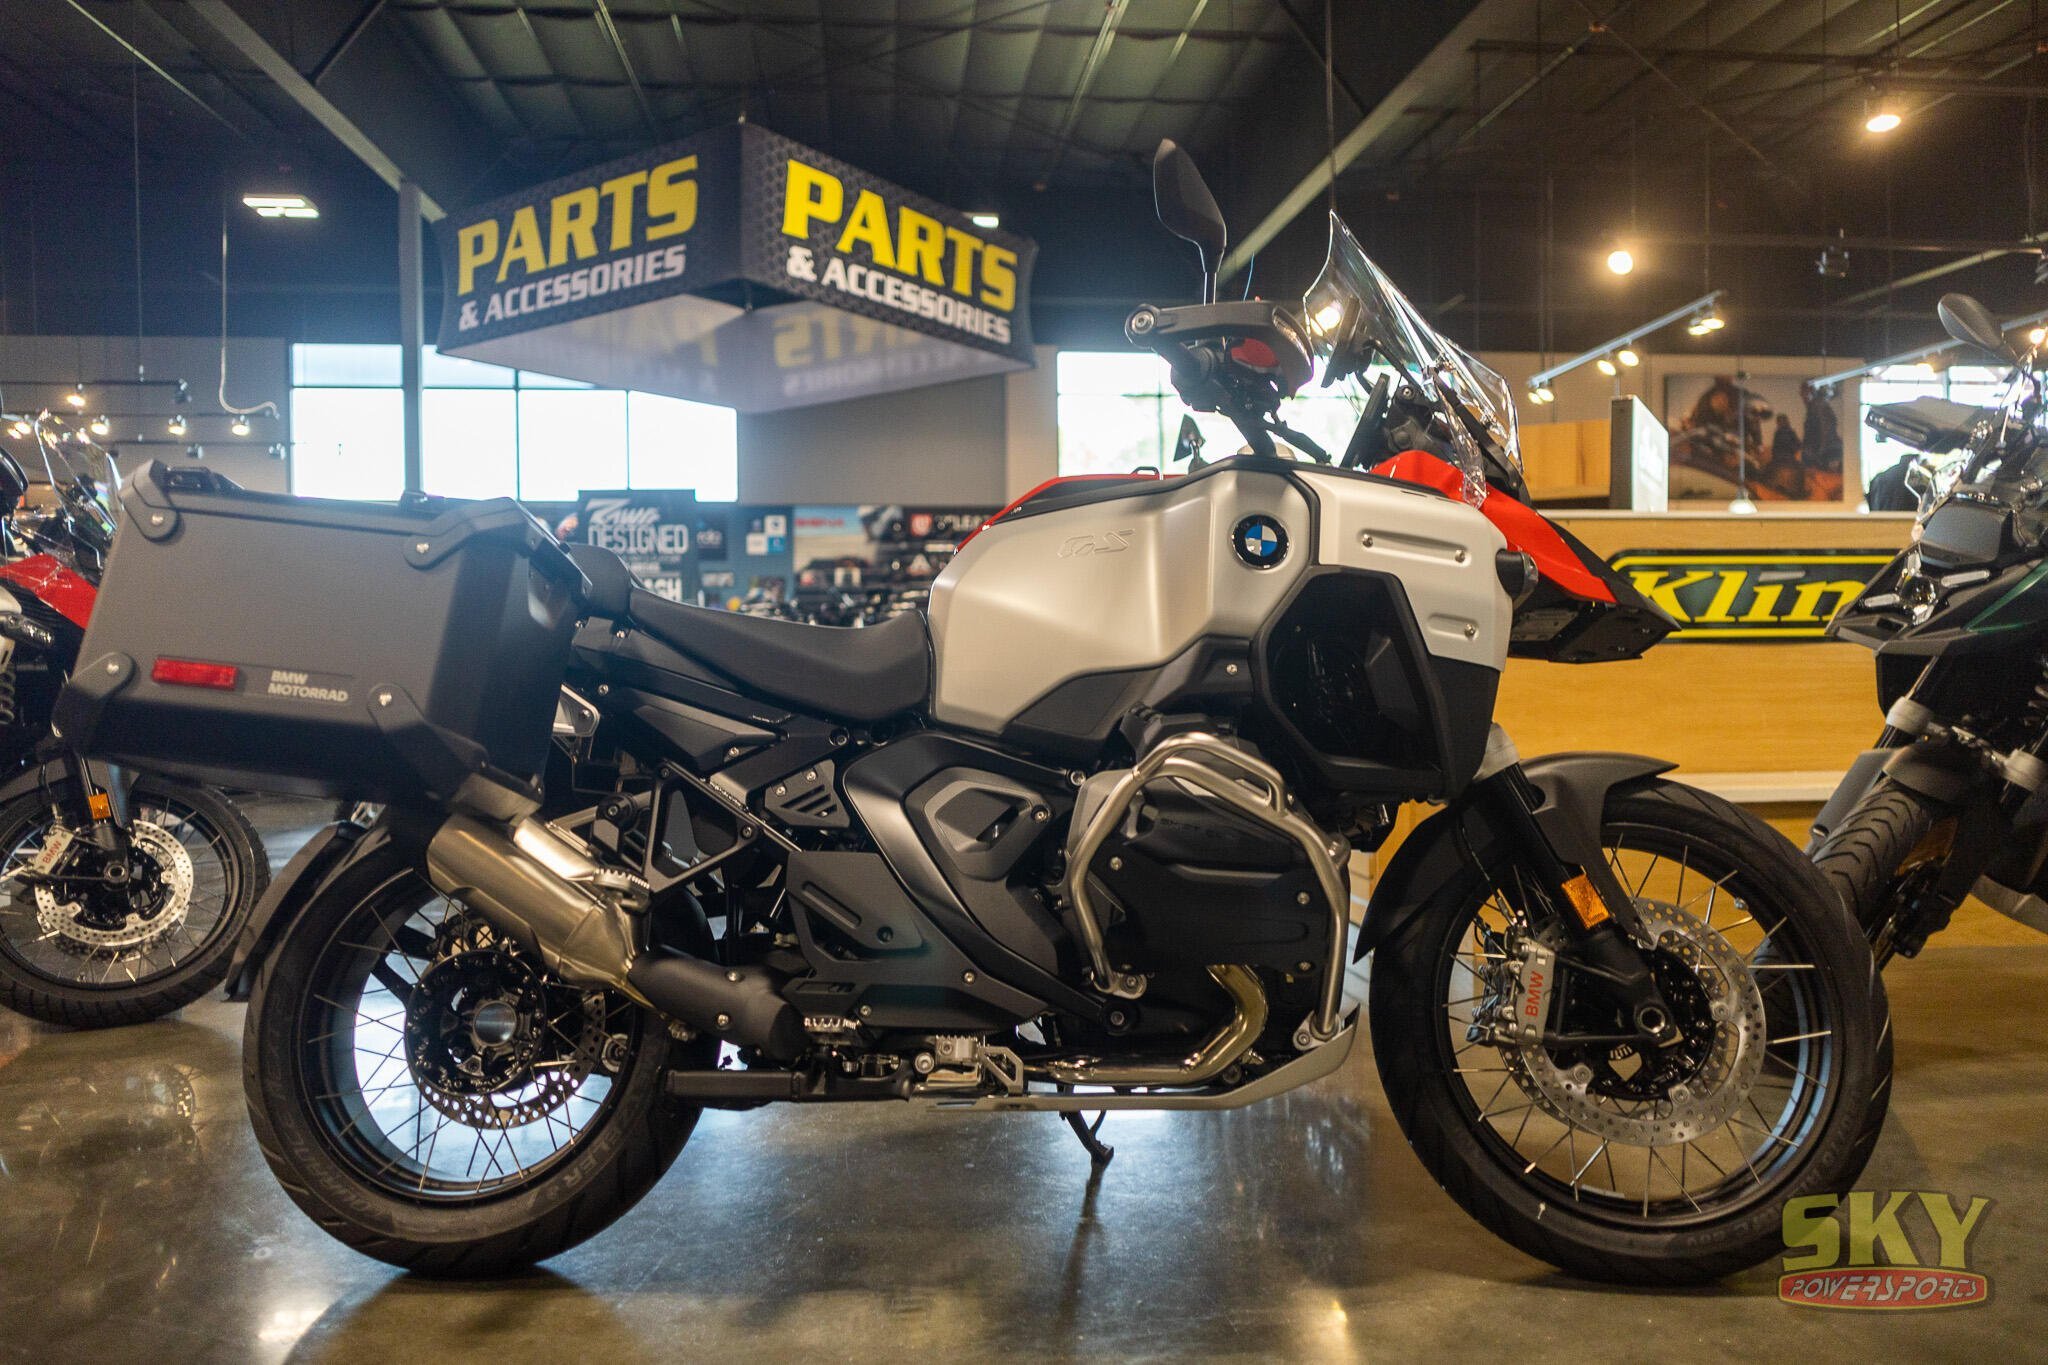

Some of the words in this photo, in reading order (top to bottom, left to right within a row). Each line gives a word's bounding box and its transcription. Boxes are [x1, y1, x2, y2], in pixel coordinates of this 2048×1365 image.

[457, 153, 698, 296] PARTS
[781, 157, 1019, 313] PARTS
[458, 301, 480, 330] &
[483, 243, 687, 326] ACCESSORIES
[786, 244, 817, 283] &
[821, 250, 1011, 345] ACCESSORIES
[587, 524, 689, 554] DESIGNED
[267, 683, 349, 702] MOTORRAD
[270, 670, 309, 685] BMW
[1525, 970, 1543, 1016] BMW
